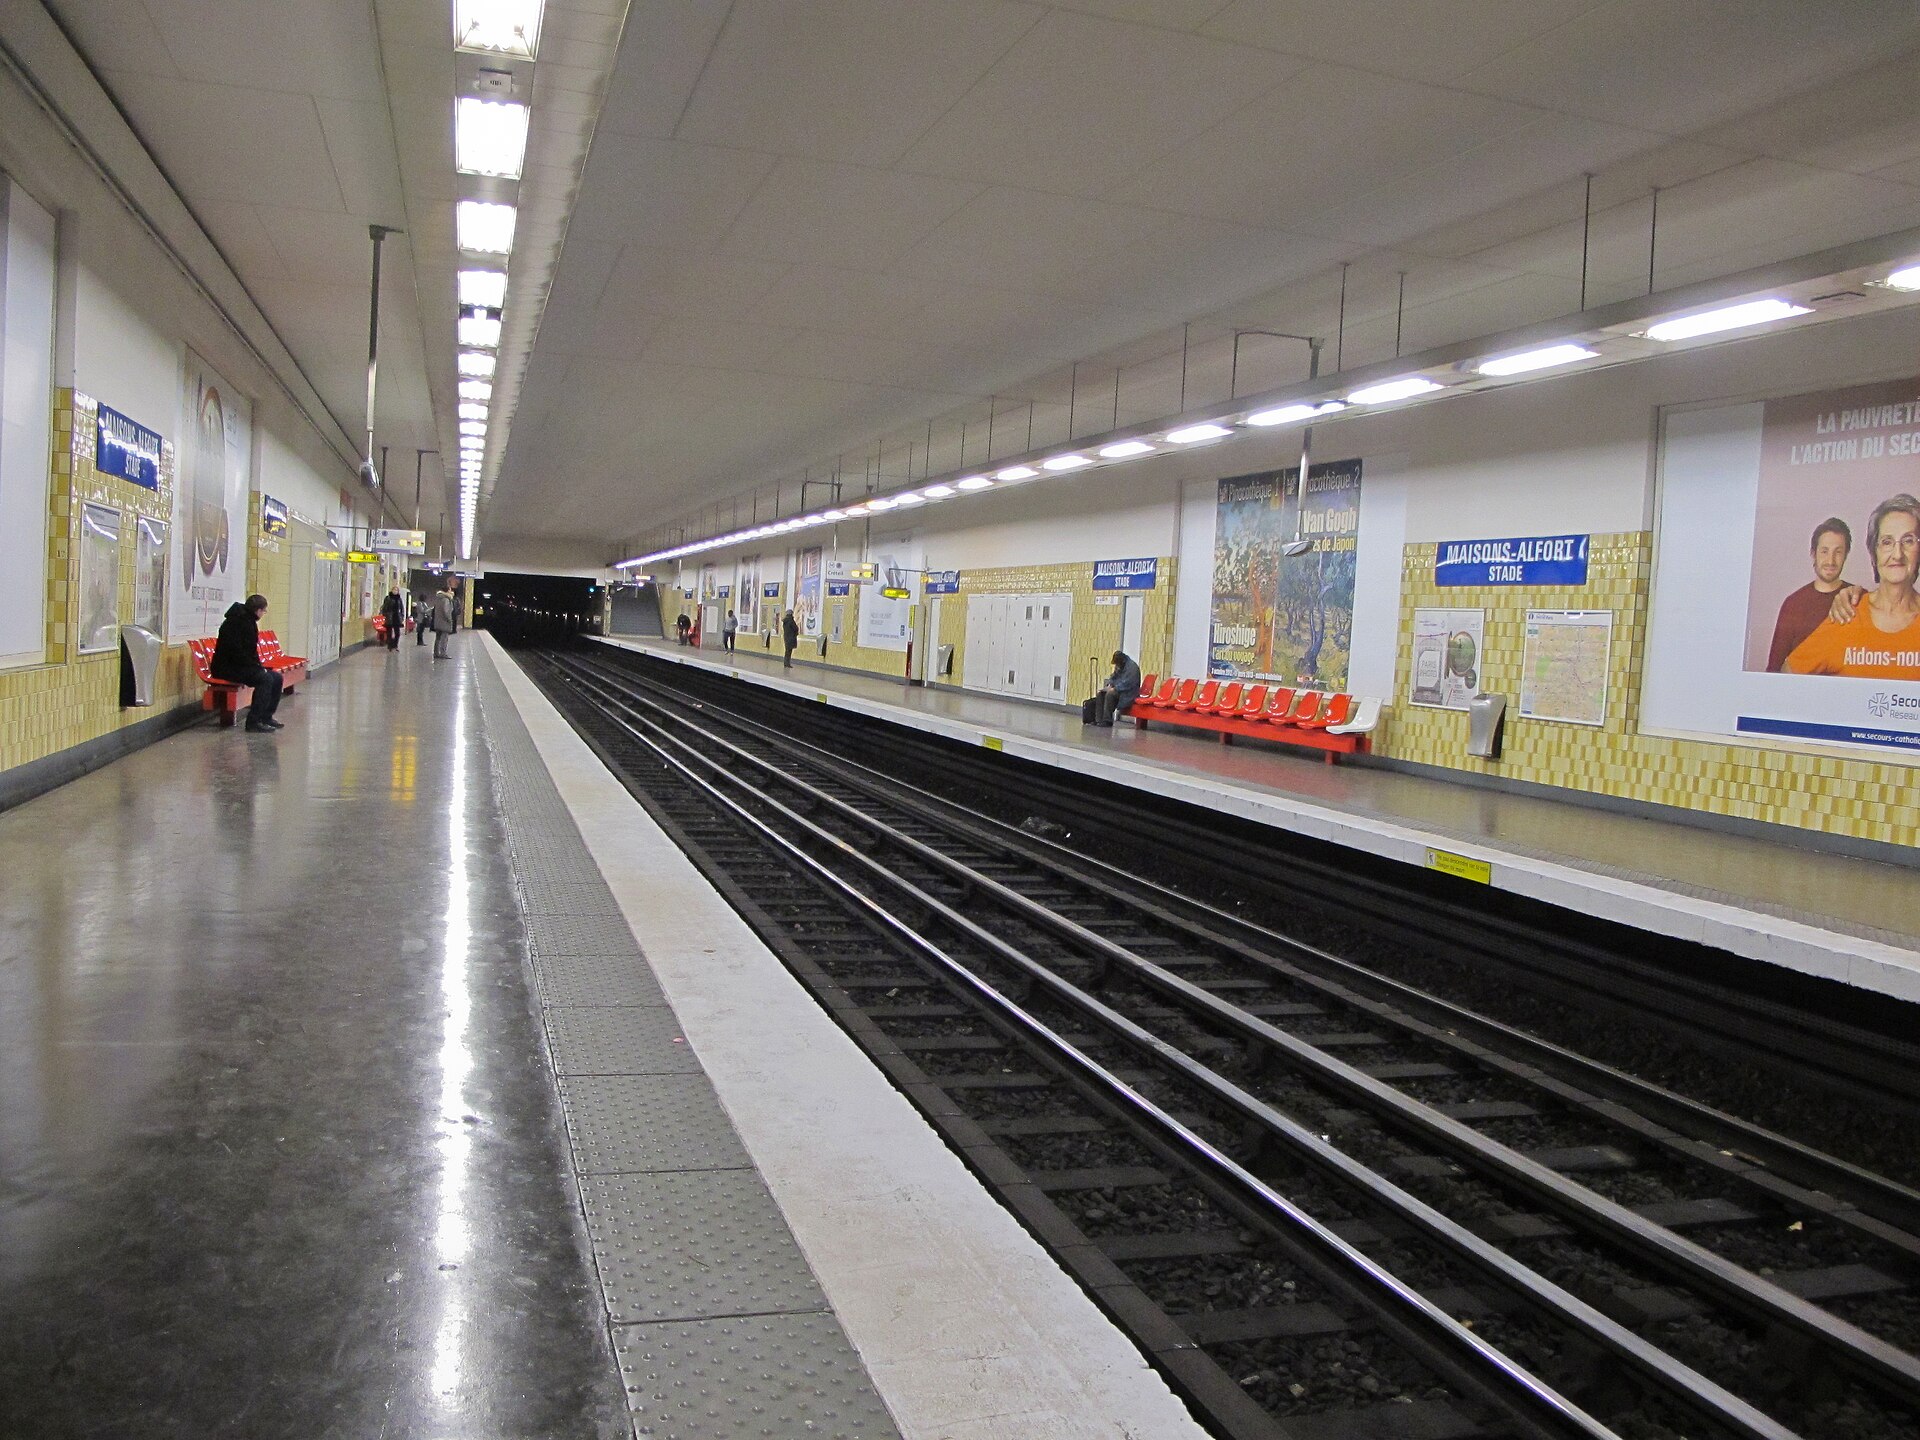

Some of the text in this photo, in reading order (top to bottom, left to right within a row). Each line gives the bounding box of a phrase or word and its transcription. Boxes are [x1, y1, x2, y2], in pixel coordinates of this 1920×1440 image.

[1816, 412, 1836, 435] LA
[1791, 438, 1858, 465] L'ACTION
[1861, 436, 1885, 459] DU
[125, 453, 141, 479] STADE
[1353, 465, 1360, 488] 2
[1302, 506, 1357, 534] Van Gogh
[1321, 536, 1331, 552] de
[1332, 536, 1355, 554] Japon
[1446, 539, 1574, 565] MAISONS-ALFORT
[1097, 560, 1151, 577] MAISONS-ALFORT
[1488, 565, 1523, 582] STADE
[1114, 576, 1130, 588] STADE
[1213, 622, 1257, 649] Hiroshige
[1233, 651, 1255, 665] voyage
[1890, 694, 1920, 708] Seco
